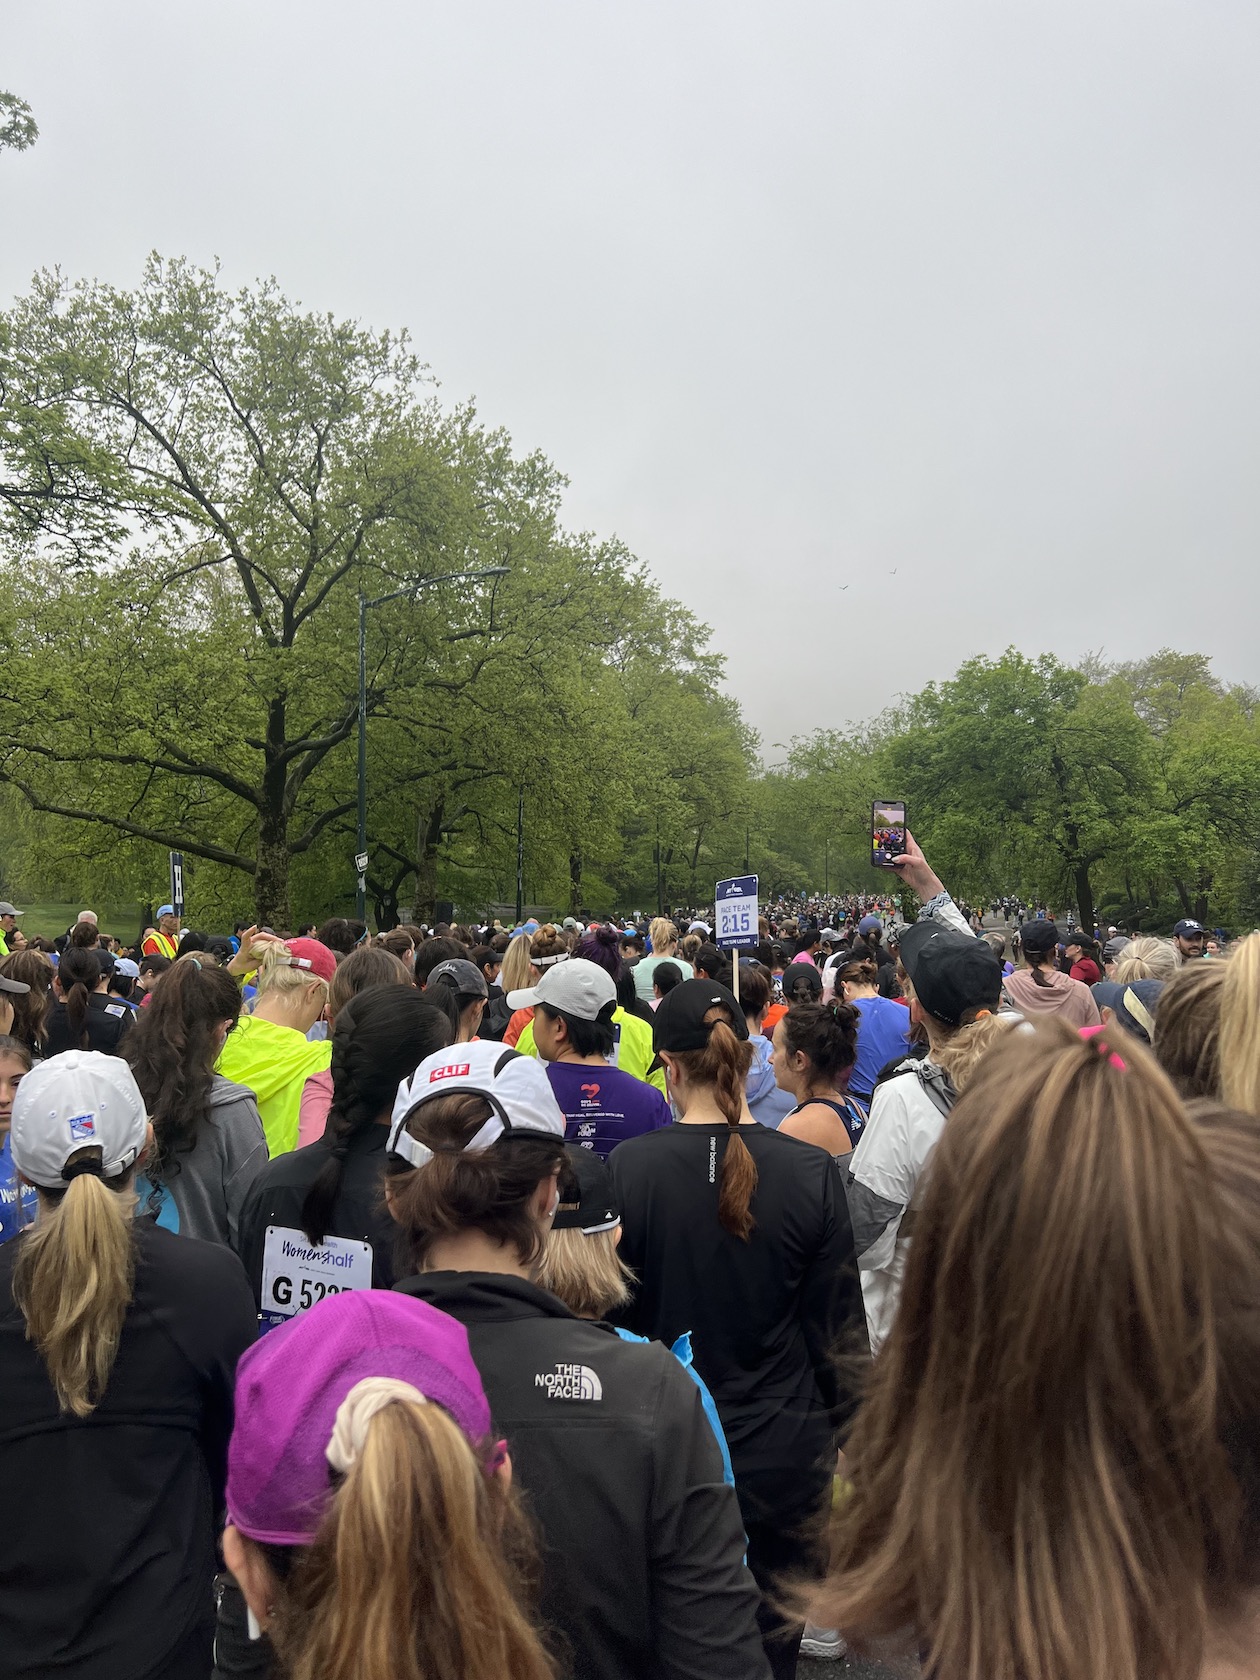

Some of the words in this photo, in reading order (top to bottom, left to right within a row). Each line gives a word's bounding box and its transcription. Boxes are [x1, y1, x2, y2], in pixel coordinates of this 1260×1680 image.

[721, 905, 731, 913] PACE
[733, 904, 750, 912] TEAM
[722, 913, 750, 933] 2:15
[434, 1064, 467, 1078] CLIF
[708, 1151, 717, 1183] balance
[282, 1240, 329, 1265] Women's
[327, 1250, 354, 1269] half
[272, 1276, 293, 1305] G
[300, 1278, 353, 1310] 52
[554, 1363, 581, 1375] THE
[534, 1373, 581, 1387] NORTH
[547, 1386, 581, 1399] FACE
